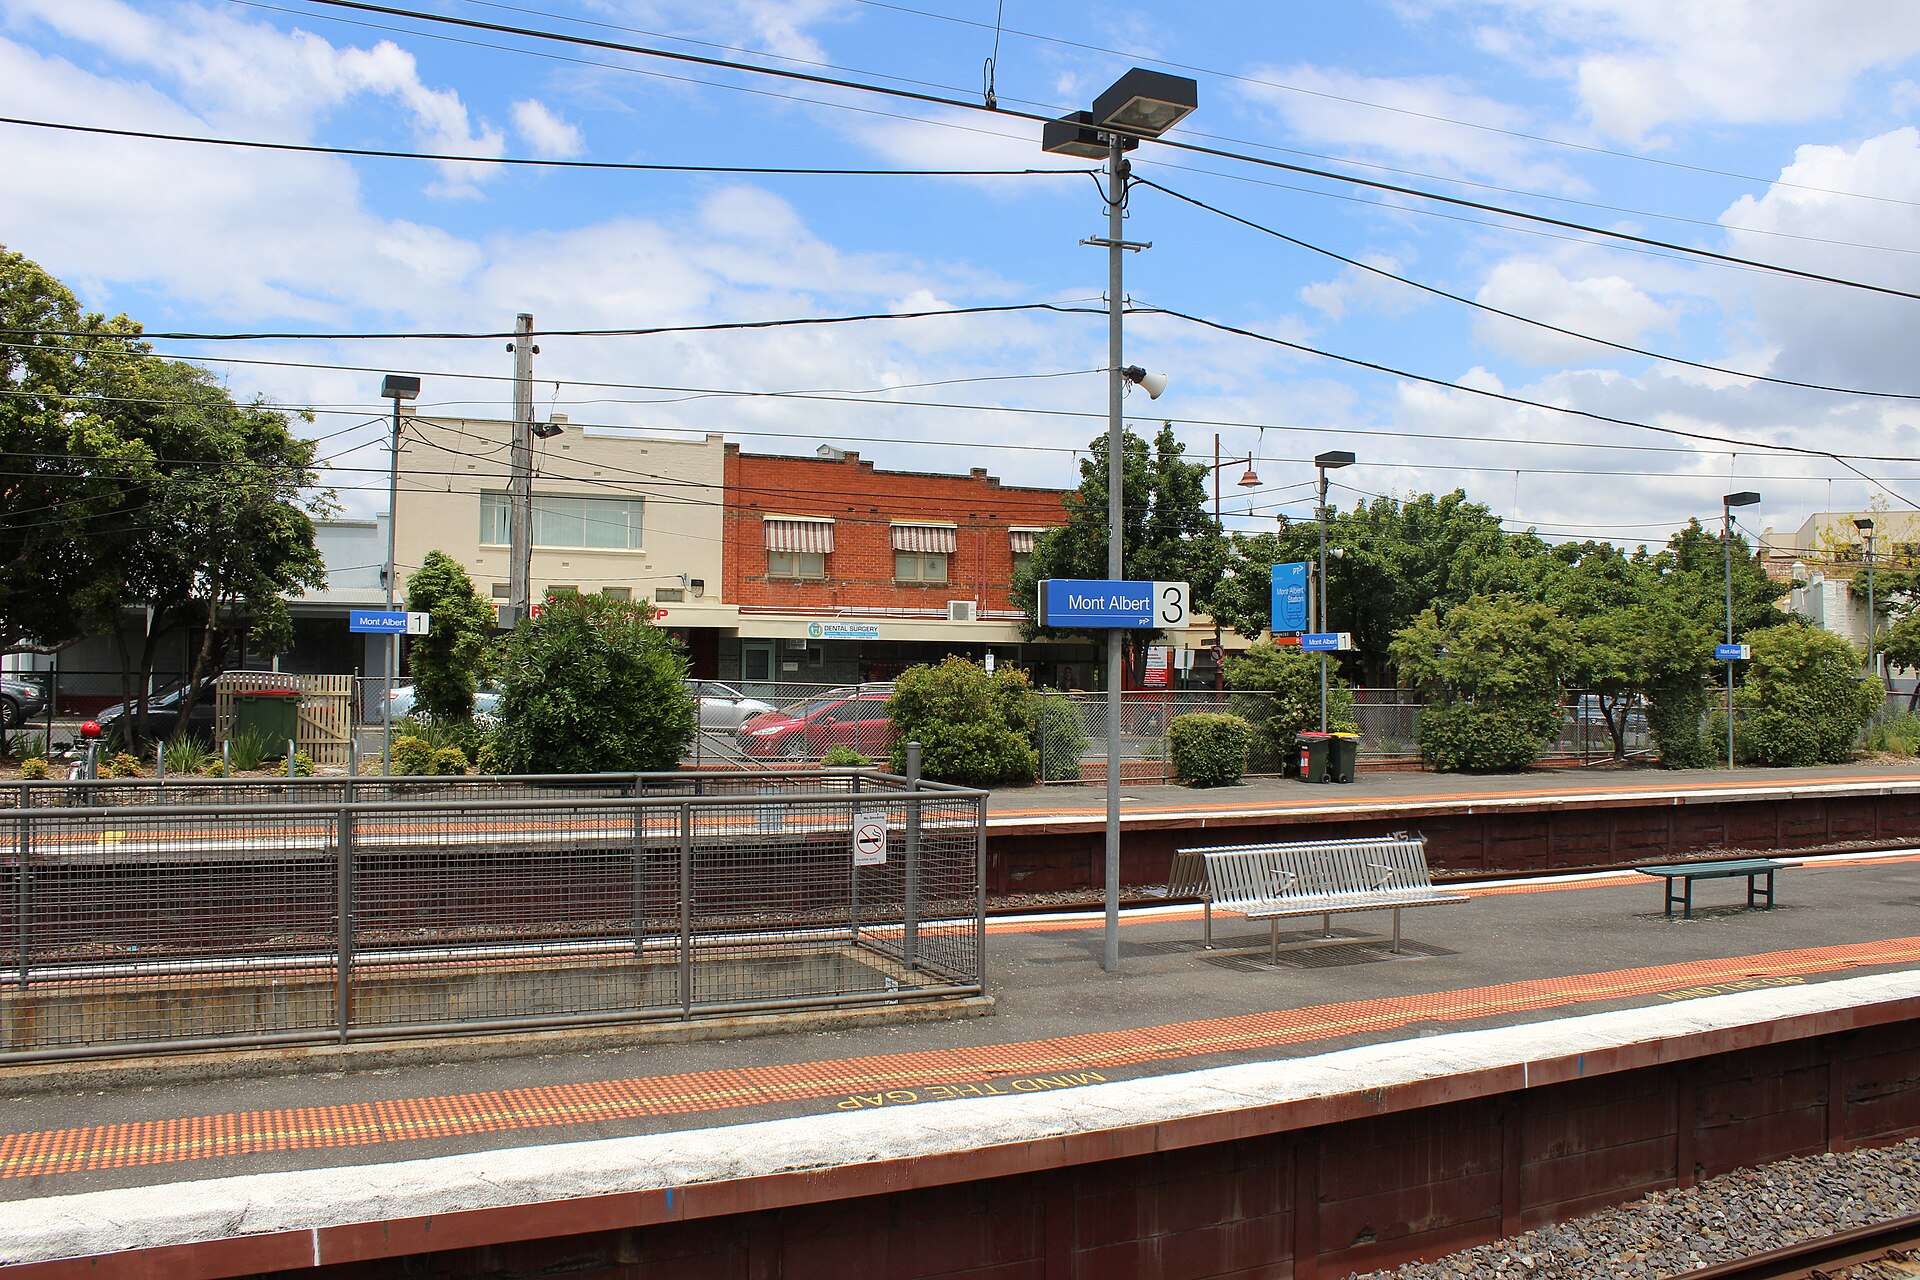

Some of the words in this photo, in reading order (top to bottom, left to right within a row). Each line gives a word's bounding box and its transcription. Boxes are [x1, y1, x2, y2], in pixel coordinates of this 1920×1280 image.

[1290, 586, 1304, 594] Albert
[1069, 595, 1104, 609] Mont
[1109, 596, 1150, 610] Albert
[1162, 587, 1183, 623] 3
[1287, 595, 1304, 603] Station
[414, 615, 421, 632] 1
[1341, 635, 1348, 648] 1
[1658, 986, 1721, 1000] MIND
[1715, 980, 1760, 991] THE
[1762, 976, 1806, 985] GAP
[1011, 1071, 1107, 1091] MIND
[837, 1090, 918, 1110] GAP
[924, 1084, 1008, 1100] THE
